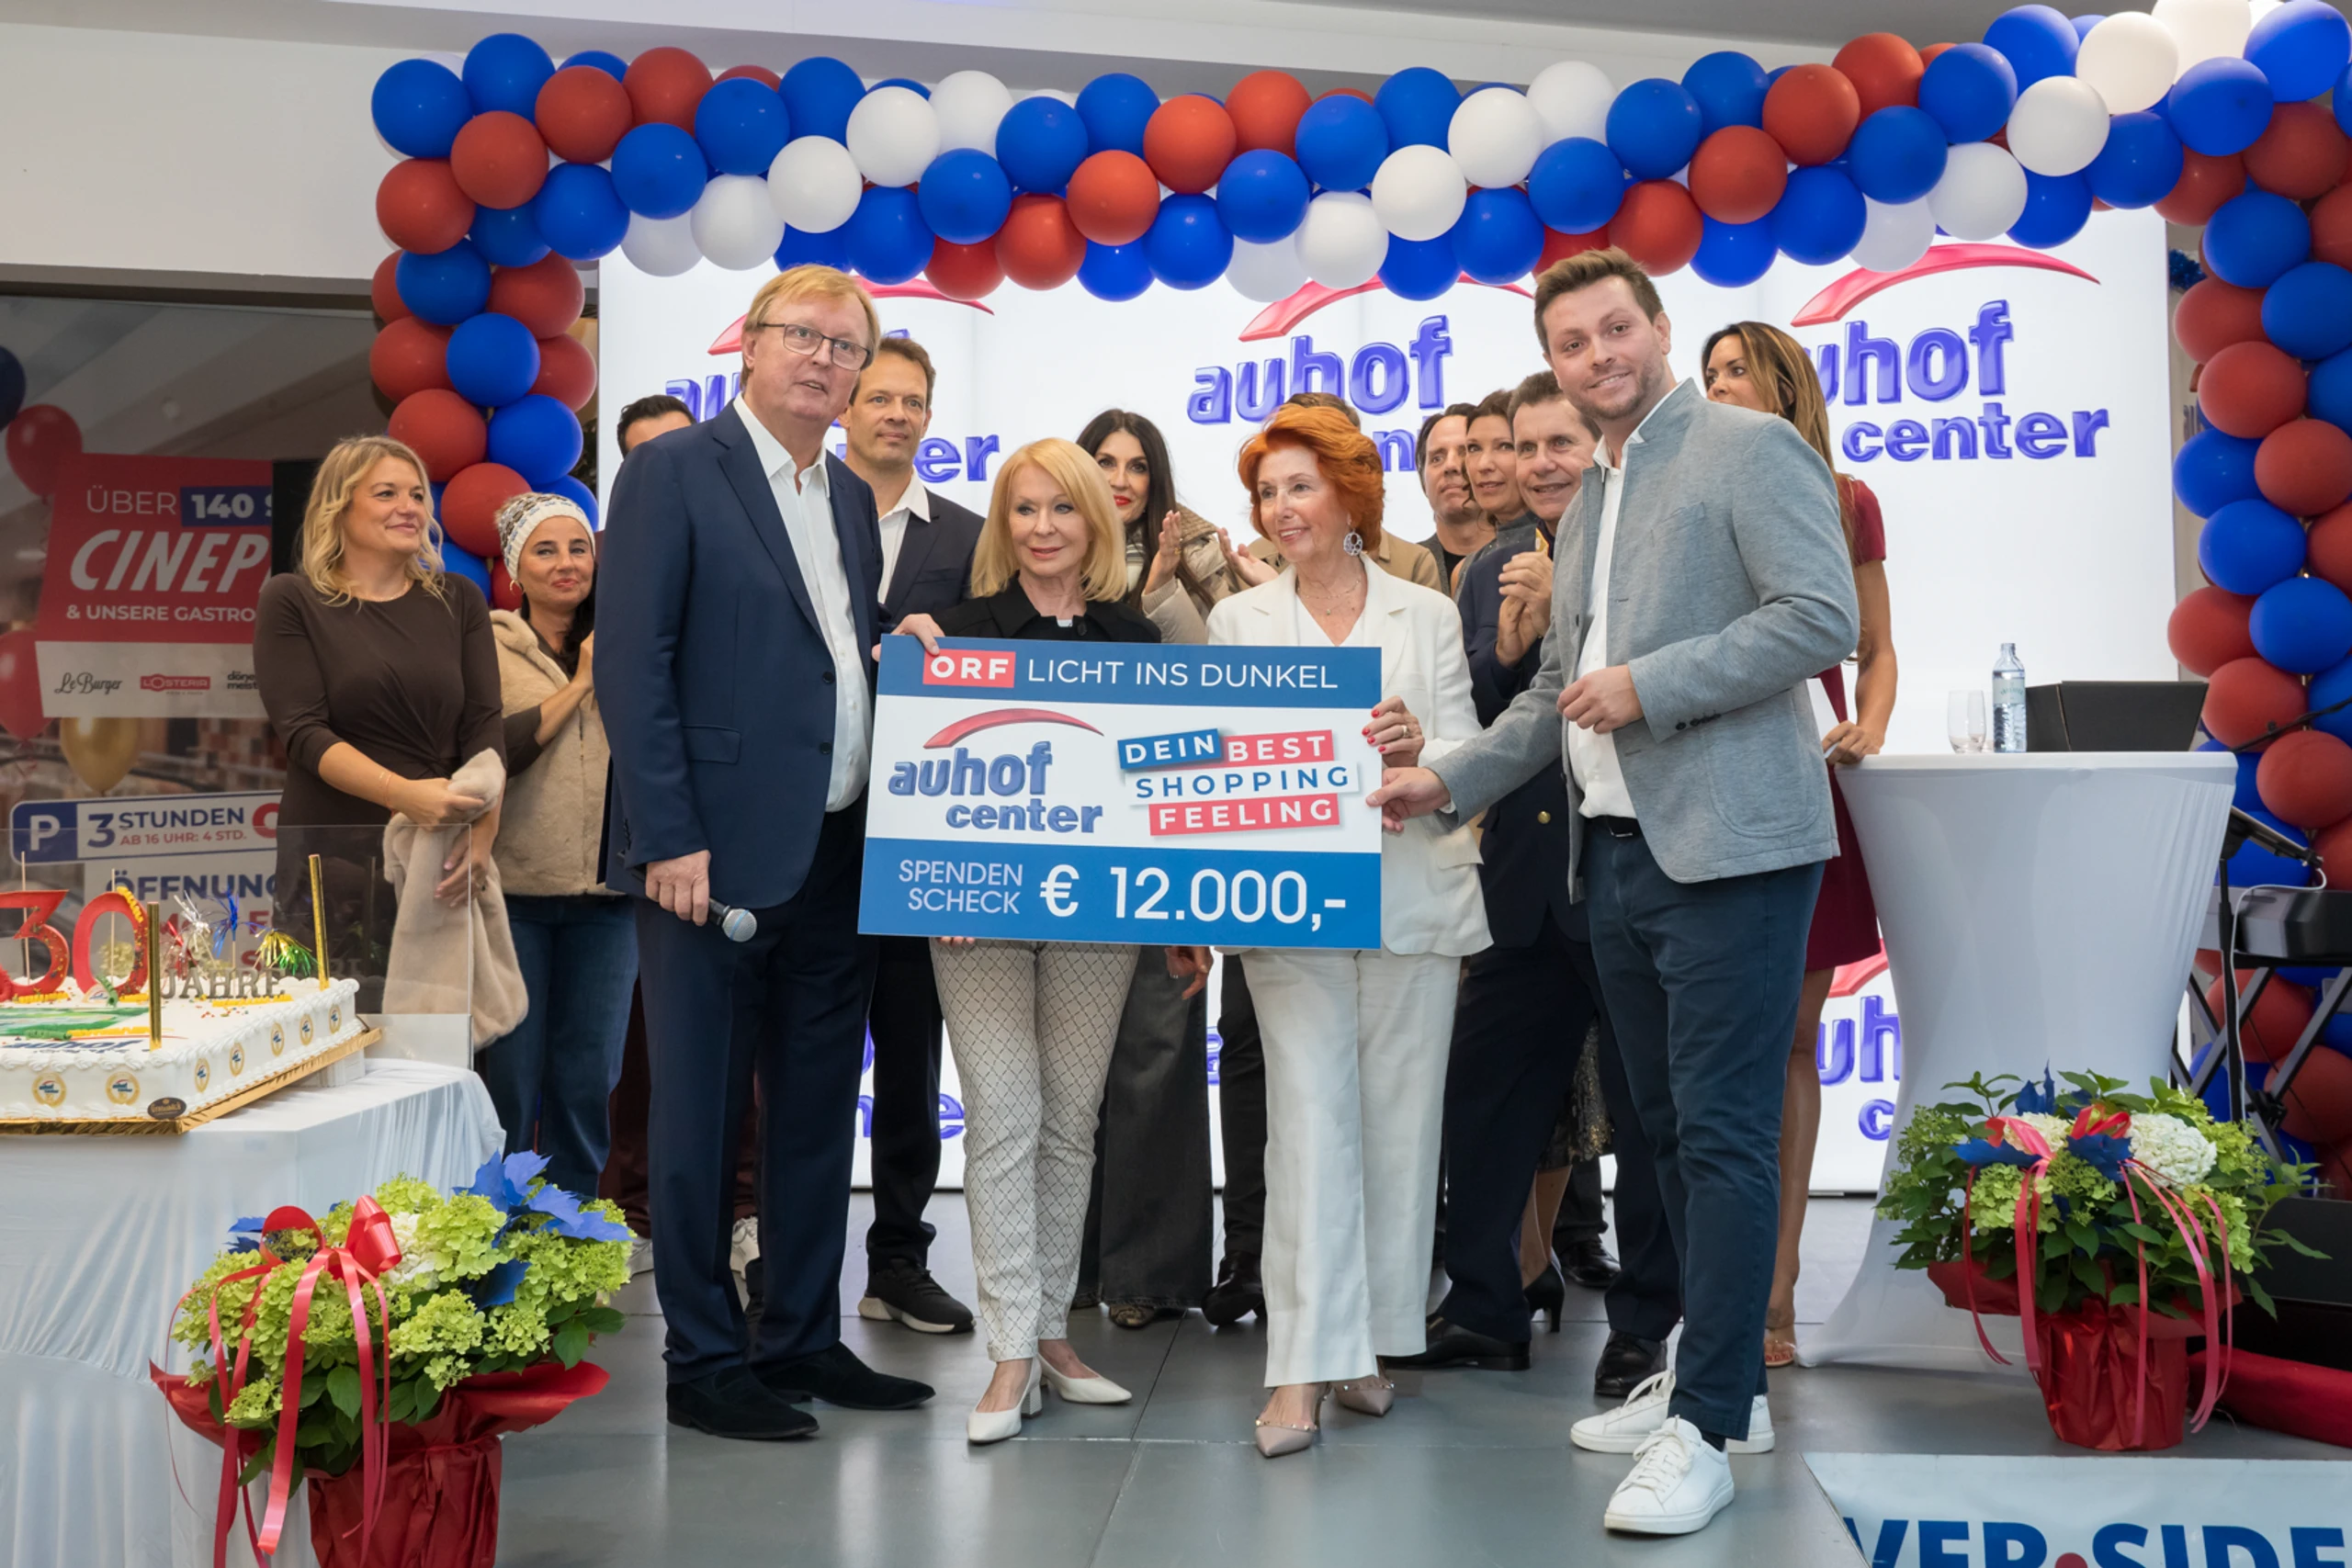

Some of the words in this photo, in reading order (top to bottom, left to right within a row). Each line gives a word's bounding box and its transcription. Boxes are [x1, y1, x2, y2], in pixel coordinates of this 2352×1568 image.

[1187, 315, 1453, 424] auhof
[1842, 402, 2110, 463] center
[86, 485, 176, 514] ÜBER
[191, 494, 254, 519] 140
[70, 529, 272, 593] CINEP
[66, 605, 81, 620] &
[86, 605, 169, 621] UNSERE
[930, 655, 1010, 681] ORF
[1028, 659, 1125, 685] LICHT
[1136, 662, 1189, 687] INS
[1200, 663, 1338, 689] DUNKEL
[1124, 735, 1216, 764] DEIN
[1227, 736, 1327, 761] BEST
[888, 741, 1053, 796] auhof
[1136, 767, 1350, 798] SHOPPING
[29, 815, 61, 852] P
[87, 813, 117, 849] 3
[119, 807, 244, 829] STUNDEN
[944, 798, 1102, 833] center
[1158, 799, 1333, 829] FEELING
[119, 834, 141, 846] AB
[146, 833, 160, 845] 16
[164, 831, 199, 844] UHR:
[202, 831, 212, 842] 4
[215, 829, 247, 841] STD.
[106, 869, 277, 901] ÖFFNUN
[899, 860, 1023, 886] SPENDEN
[907, 888, 1021, 915] SCHECK
[1040, 864, 1080, 918] €
[1110, 866, 1347, 932] 12.000,-
[0, 889, 150, 1001] 30
[160, 967, 286, 999] JAHRE
